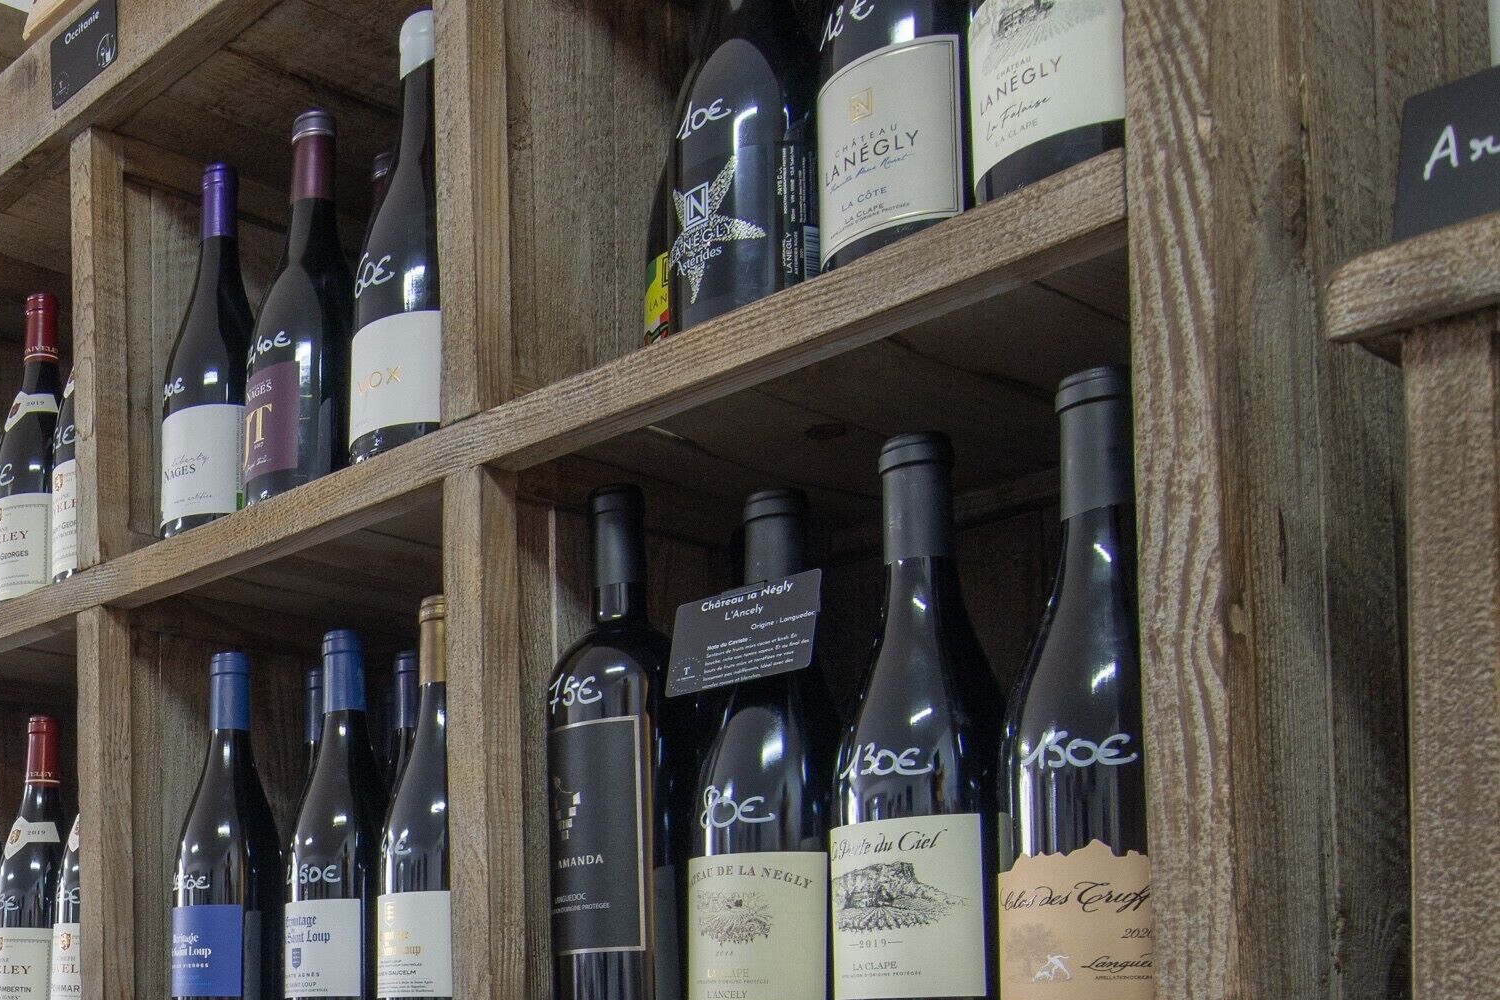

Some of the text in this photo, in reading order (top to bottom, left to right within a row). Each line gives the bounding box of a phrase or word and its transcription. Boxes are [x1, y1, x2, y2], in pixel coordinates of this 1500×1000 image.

[65, 9, 100, 45] Occitanie
[835, 122, 899, 159] CHÂTEAU
[842, 129, 919, 174] NÉGLY
[354, 252, 395, 298] 60€
[761, 580, 794, 598] Négly
[724, 604, 764, 622] L'Ancely
[750, 610, 816, 631] Origine Languedoc
[550, 673, 602, 714] 15€
[840, 742, 933, 780] 130€
[1022, 730, 1138, 769] 150€
[701, 784, 776, 829] 80€
[898, 828, 948, 852] Ciel
[716, 865, 734, 876] DE
[738, 864, 756, 877] LA
[859, 938, 887, 949] 2019
